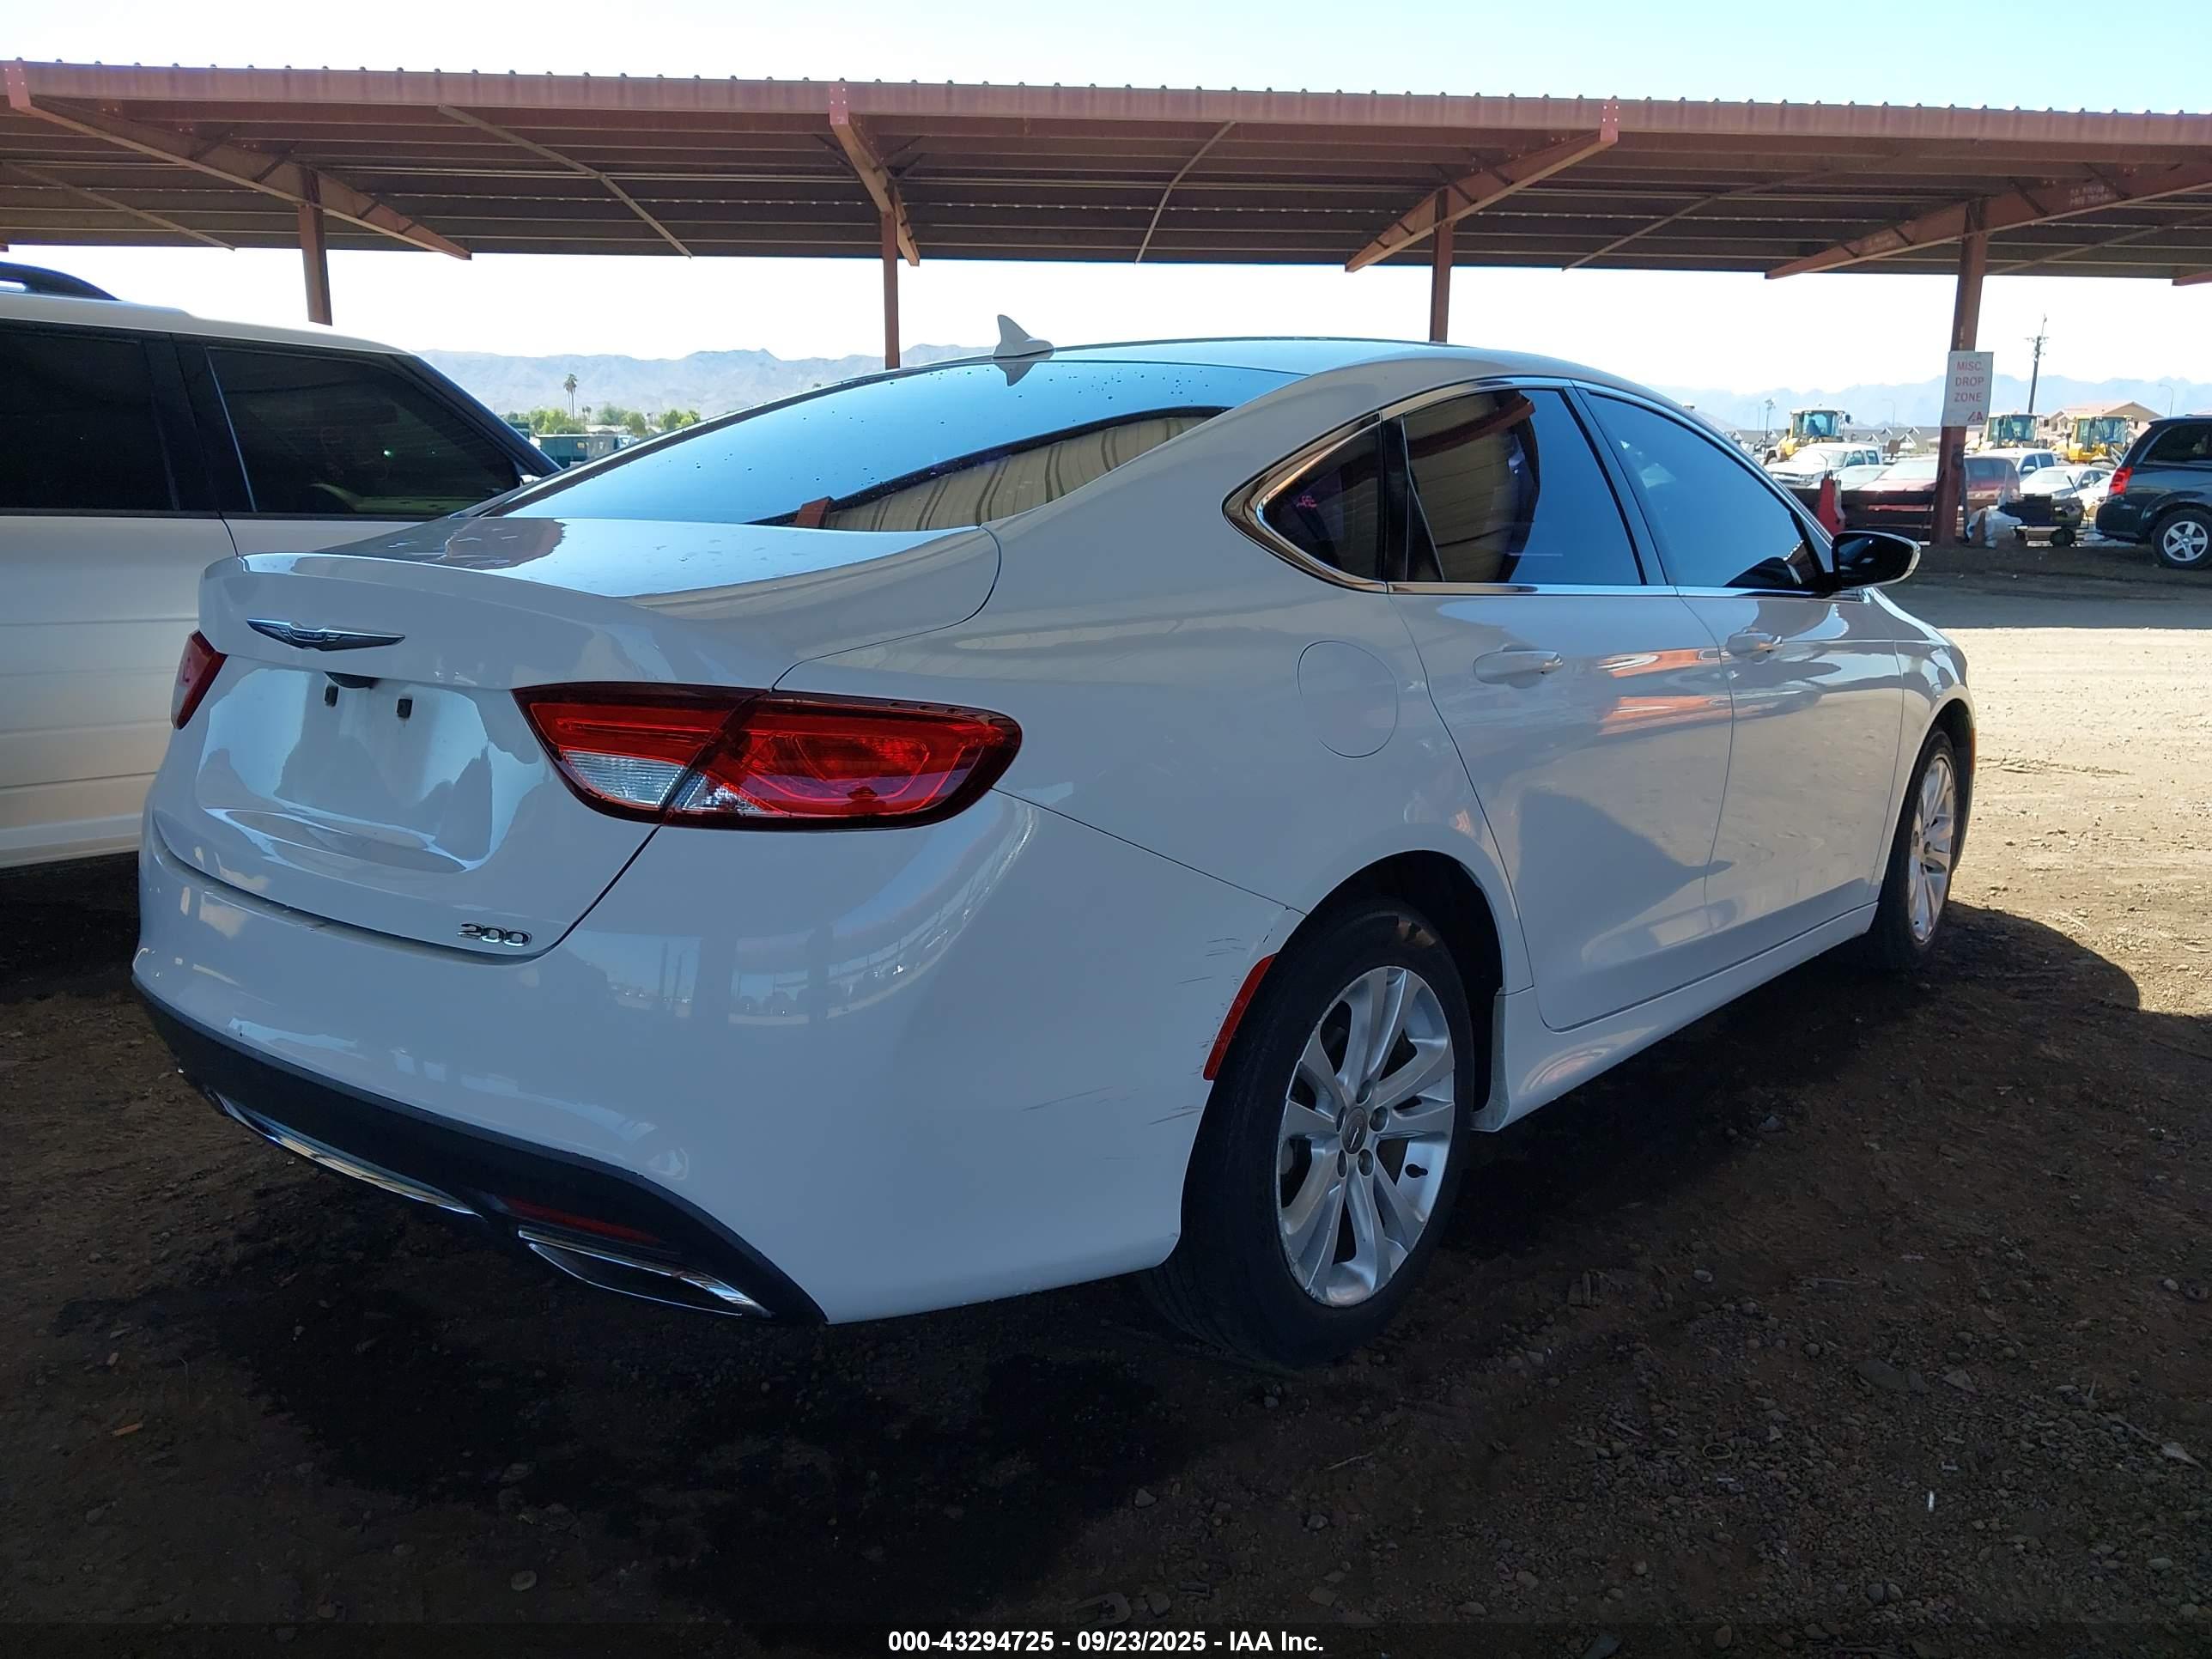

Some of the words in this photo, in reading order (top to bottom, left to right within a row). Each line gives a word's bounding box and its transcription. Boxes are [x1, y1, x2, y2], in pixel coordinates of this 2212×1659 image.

[1956, 361, 1984, 371] MISC.
[1955, 377, 1984, 386] DROP
[1954, 392, 1982, 403] ZONE
[457, 923, 531, 947] 200
